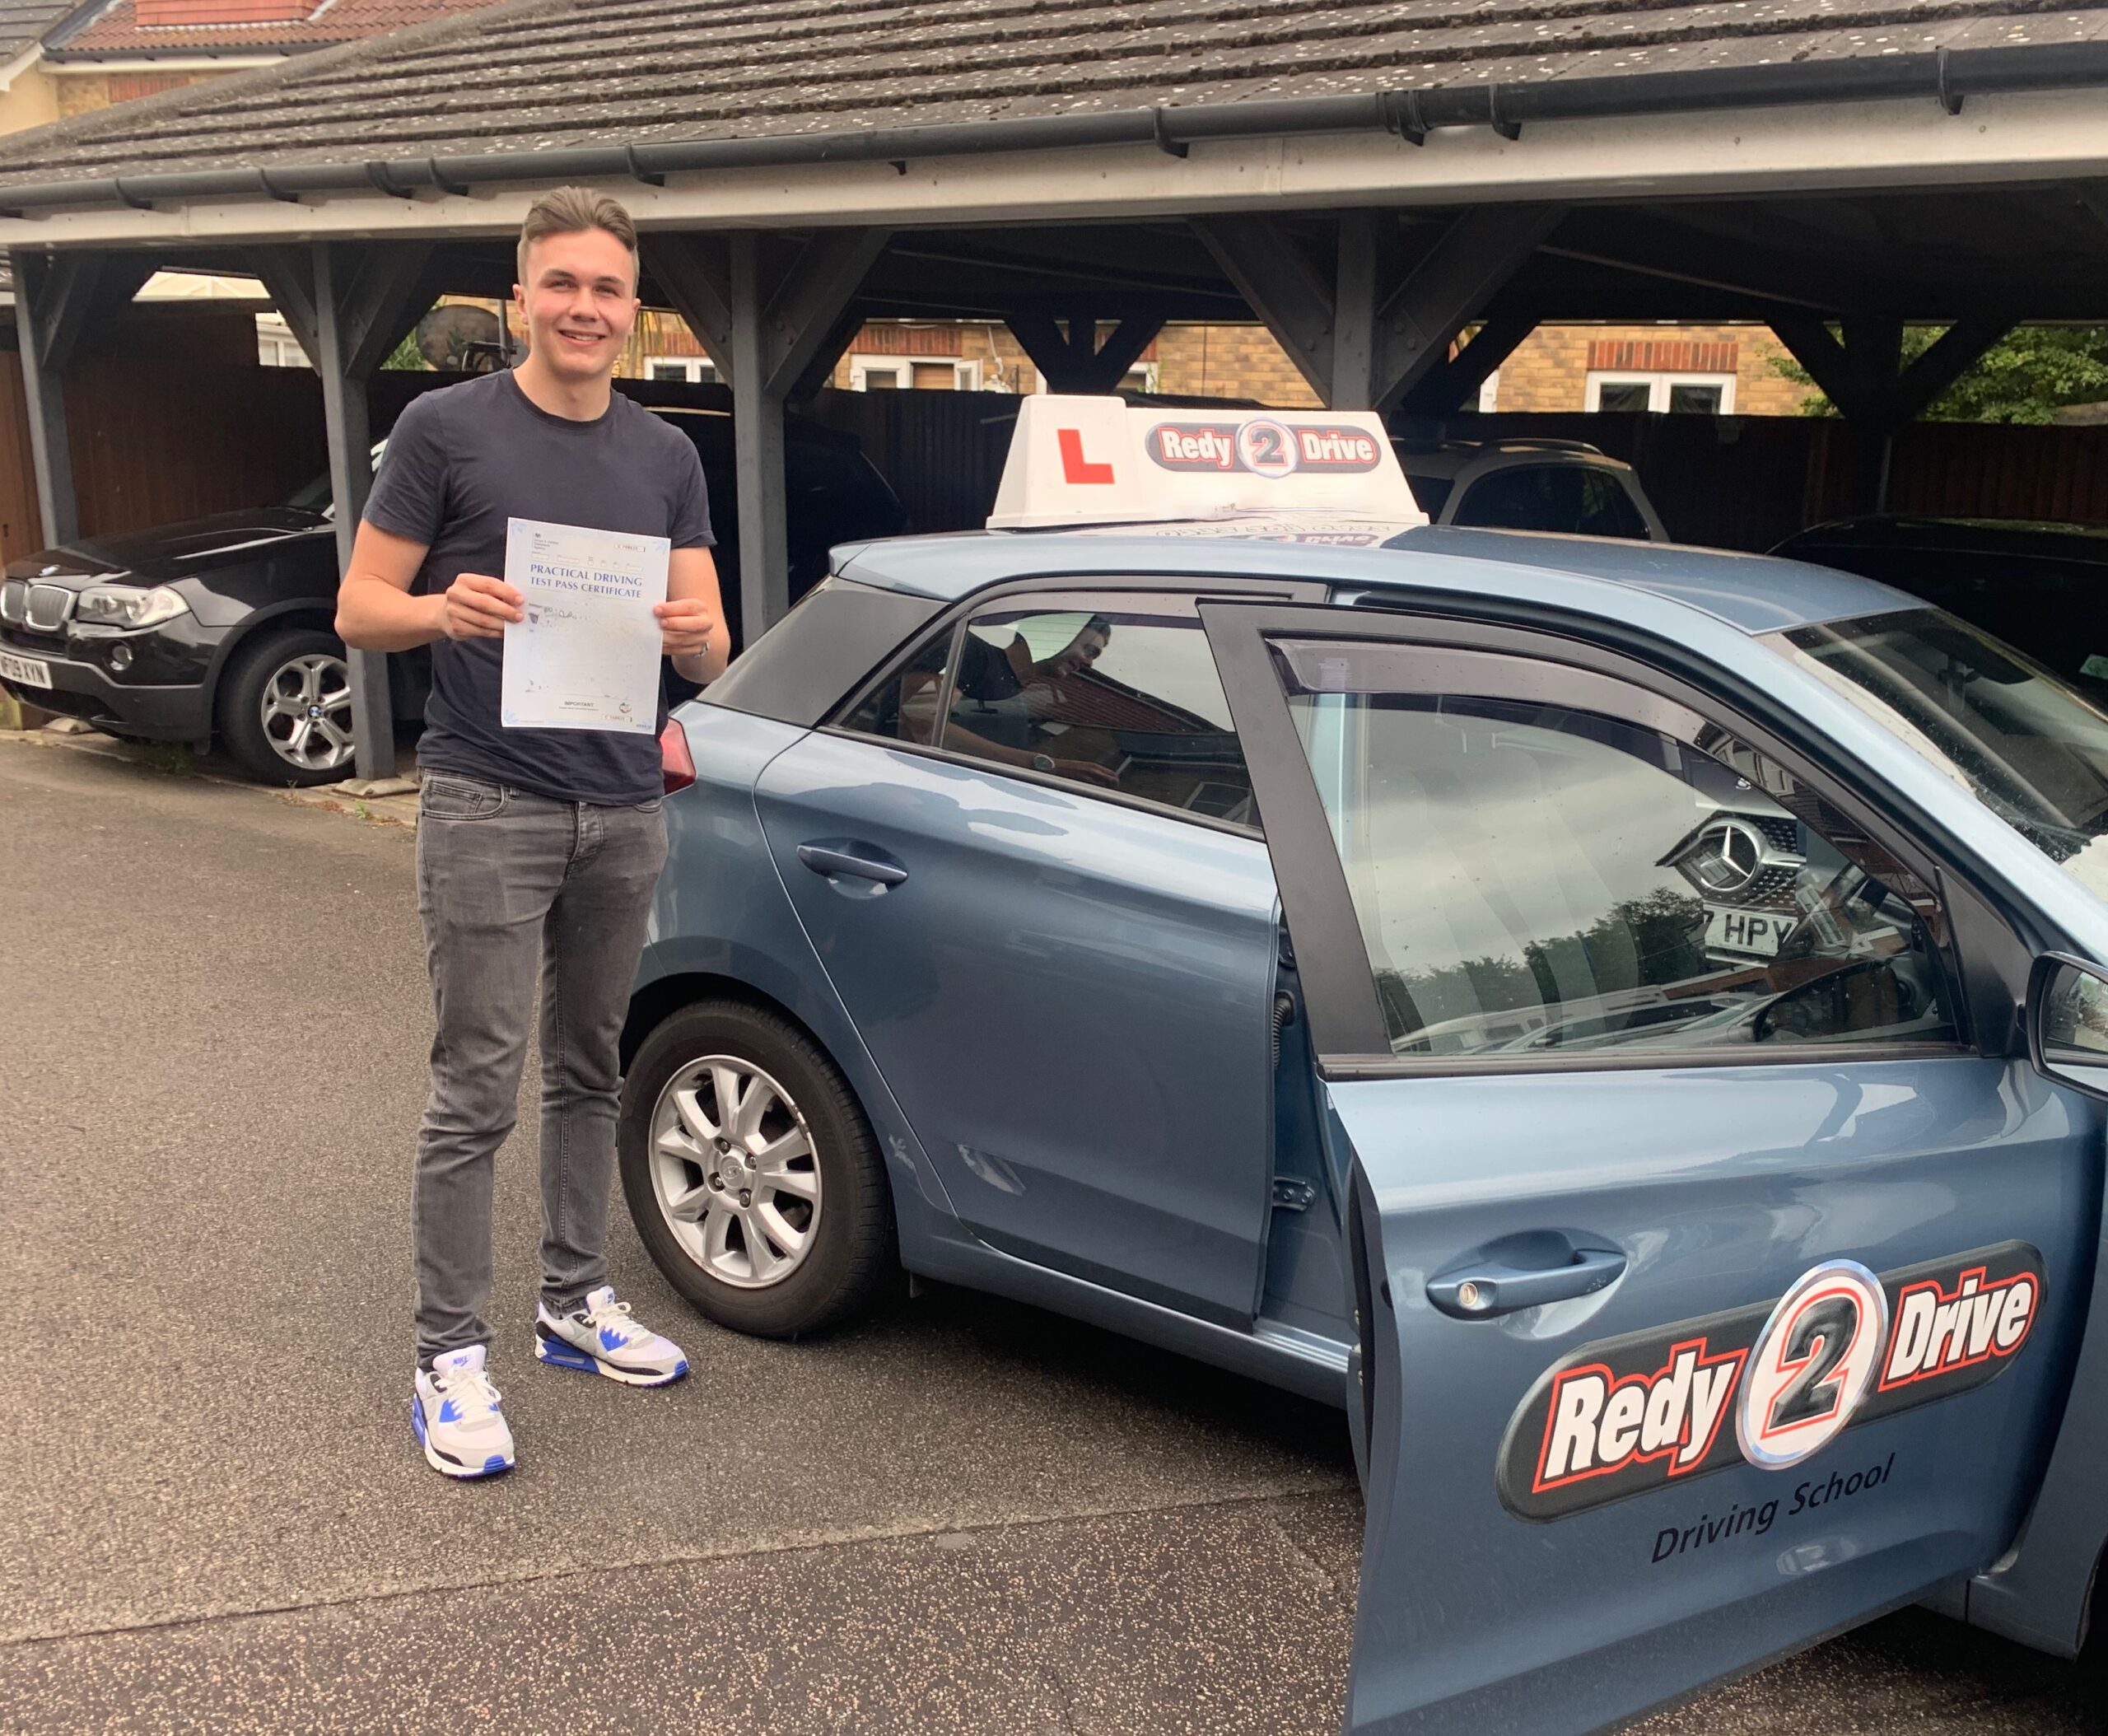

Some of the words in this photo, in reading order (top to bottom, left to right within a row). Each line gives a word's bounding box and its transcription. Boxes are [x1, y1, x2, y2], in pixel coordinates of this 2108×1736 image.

[1056, 428, 1115, 484] L
[1159, 428, 1233, 468] Redy
[1251, 427, 1288, 466] 2
[1302, 430, 1375, 463] Drive
[530, 563, 590, 581] PRACTICAL
[594, 572, 643, 587] DRIVING
[531, 576, 553, 587] TEST
[555, 580, 578, 590] PASS
[581, 583, 642, 599] CERTIFICATE
[1541, 1349, 1739, 1481] Redy
[1767, 1294, 1858, 1434] 2
[1886, 1279, 2033, 1382] Drive
[1650, 1498, 1779, 1562] Driving
[1789, 1452, 1895, 1515] School
